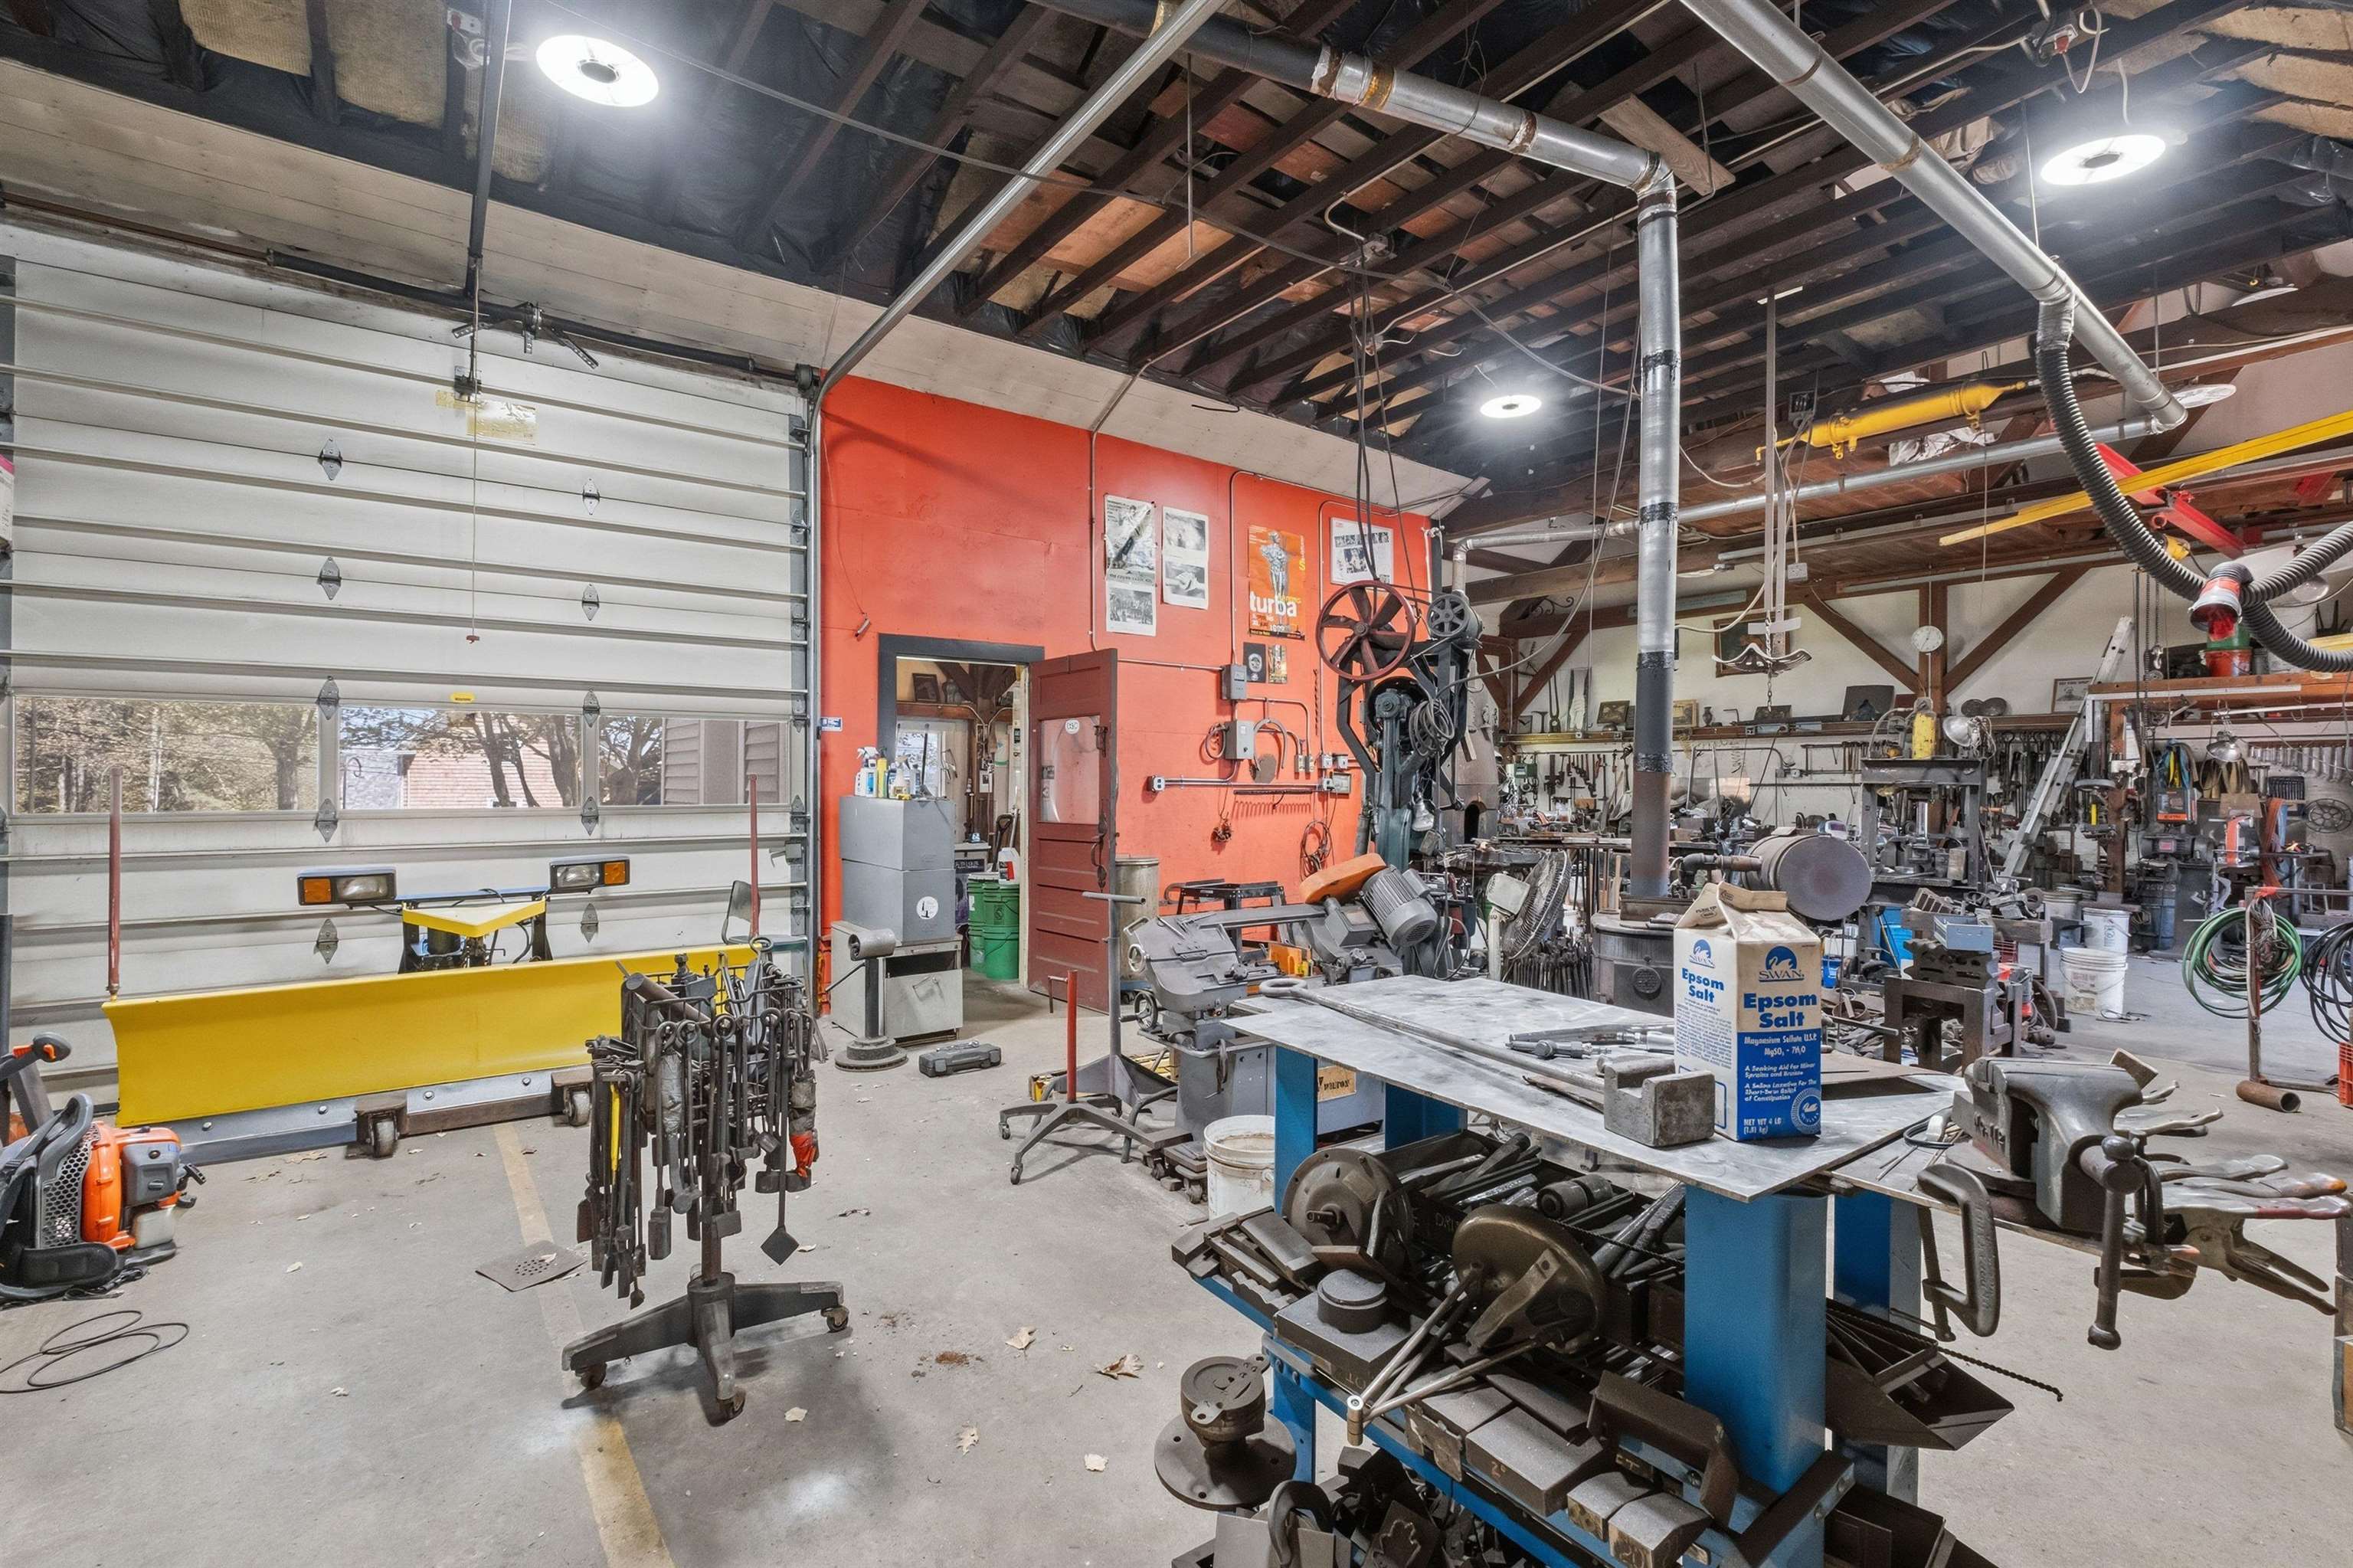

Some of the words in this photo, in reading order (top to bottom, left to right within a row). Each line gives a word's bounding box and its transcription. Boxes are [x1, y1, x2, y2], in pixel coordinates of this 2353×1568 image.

[1249, 591, 1297, 617] turba
[1681, 967, 1724, 991] Epsom
[1759, 970, 1801, 980] SWAN
[1688, 985, 1715, 1003] Salt
[1743, 993, 1818, 1013] Epsom
[1759, 1011, 1805, 1028] Salt
[1744, 1036, 1781, 1046] Magnesium
